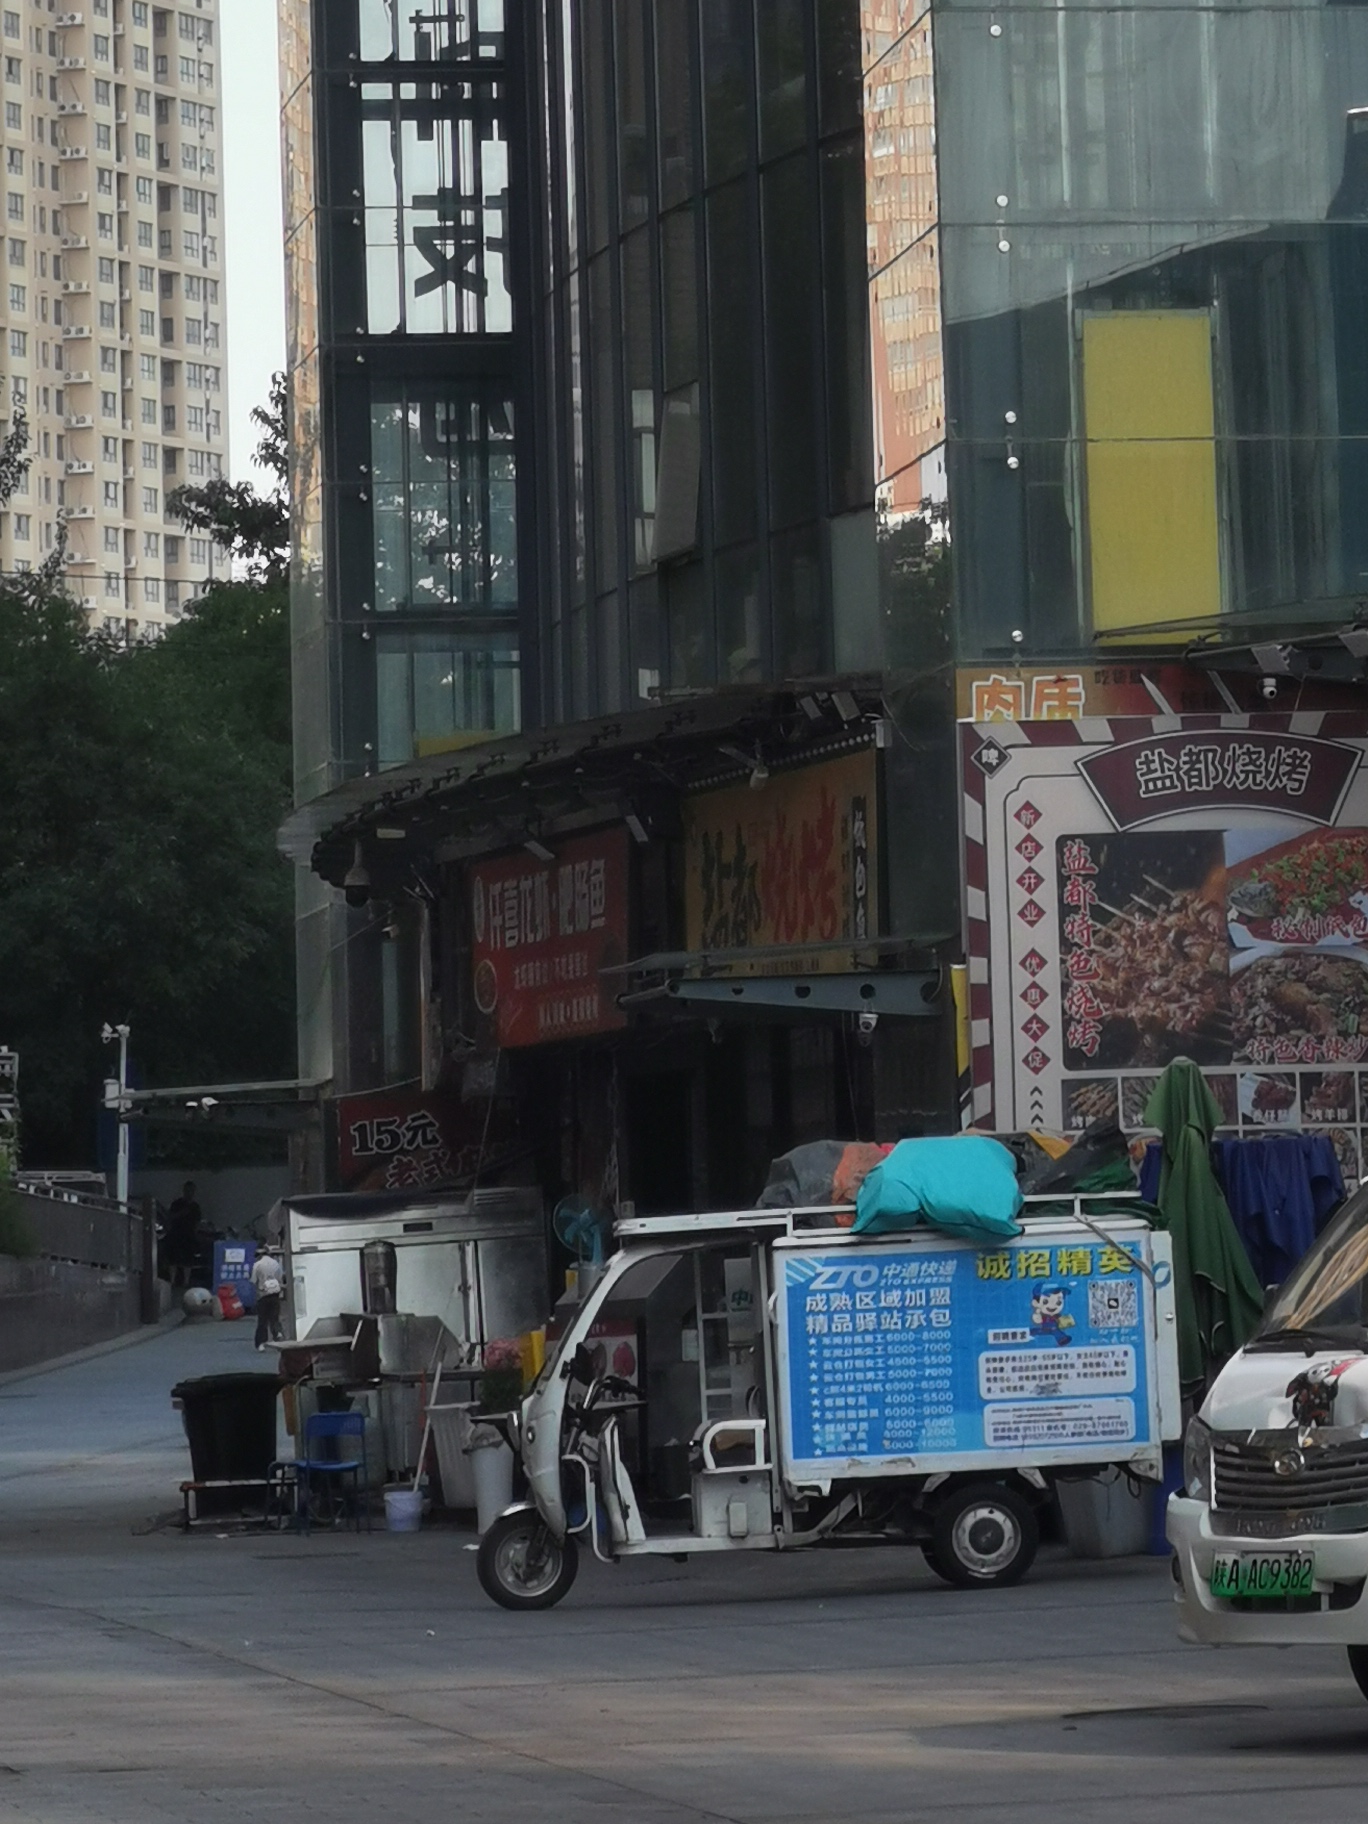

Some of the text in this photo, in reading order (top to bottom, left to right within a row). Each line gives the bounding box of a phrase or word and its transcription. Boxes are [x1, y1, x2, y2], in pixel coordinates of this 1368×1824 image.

[980, 747, 999, 766] 啤
[1134, 745, 1313, 798] 盐都烧烤
[1020, 809, 1045, 1069] 新店开业 优惠大促
[1062, 839, 1103, 1057] 盐都特色烧烤
[351, 1110, 442, 1156] 15元
[809, 1264, 880, 1291] ZTO
[881, 1259, 958, 1277] 中通快递
[976, 1244, 1134, 1280] 诚招精英
[805, 1287, 952, 1312] 成熟区域加盟
[805, 1309, 952, 1335] 精品驿站承包
